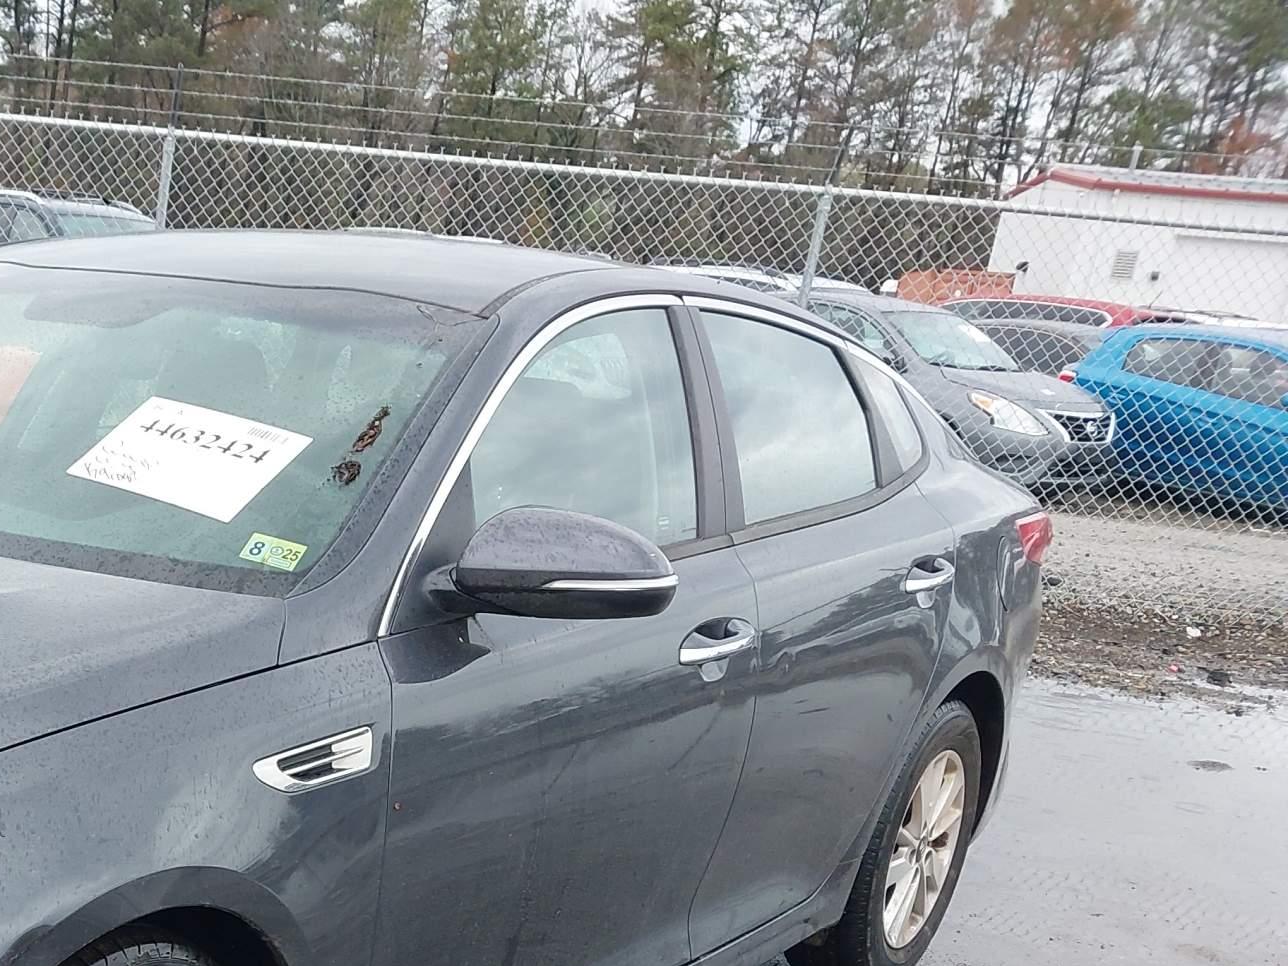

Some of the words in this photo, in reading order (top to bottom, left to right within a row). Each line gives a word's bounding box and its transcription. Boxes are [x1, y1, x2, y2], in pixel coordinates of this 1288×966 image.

[140, 419, 271, 464] 44632424
[248, 541, 266, 556] 8
[281, 548, 302, 562] 25
